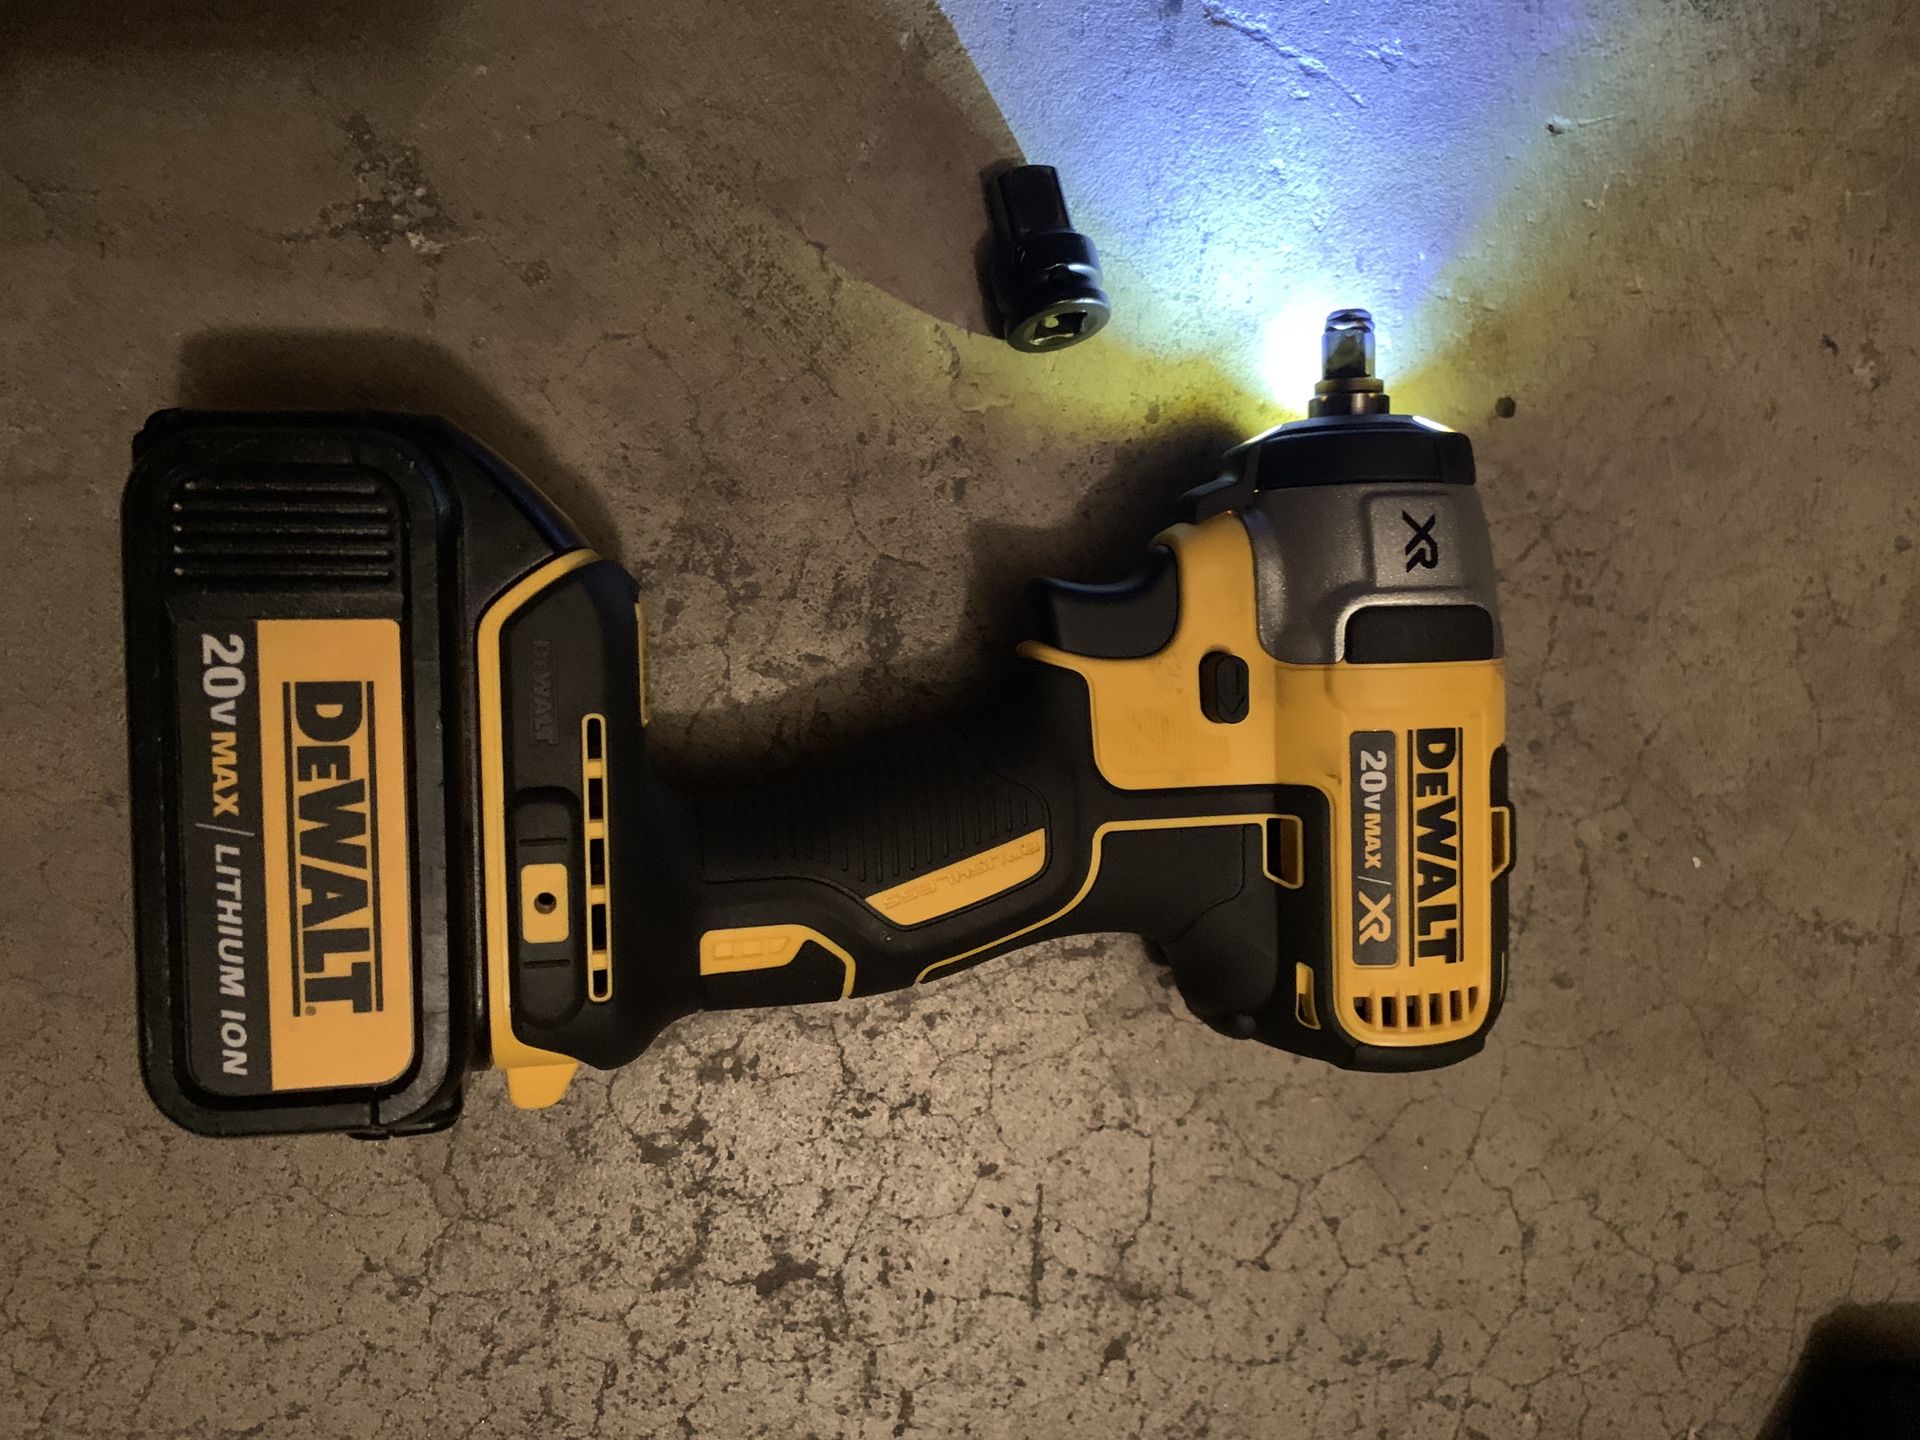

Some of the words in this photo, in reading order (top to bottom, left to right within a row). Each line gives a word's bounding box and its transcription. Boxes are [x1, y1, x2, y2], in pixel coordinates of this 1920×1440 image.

[1401, 510, 1439, 573] XR
[211, 732, 242, 817] MAX
[1363, 813, 1382, 869] MAX
[1415, 727, 1458, 965] DEWALT
[214, 843, 245, 996] LITHIUM
[1357, 890, 1392, 946] XR
[221, 1010, 249, 1076] ION
